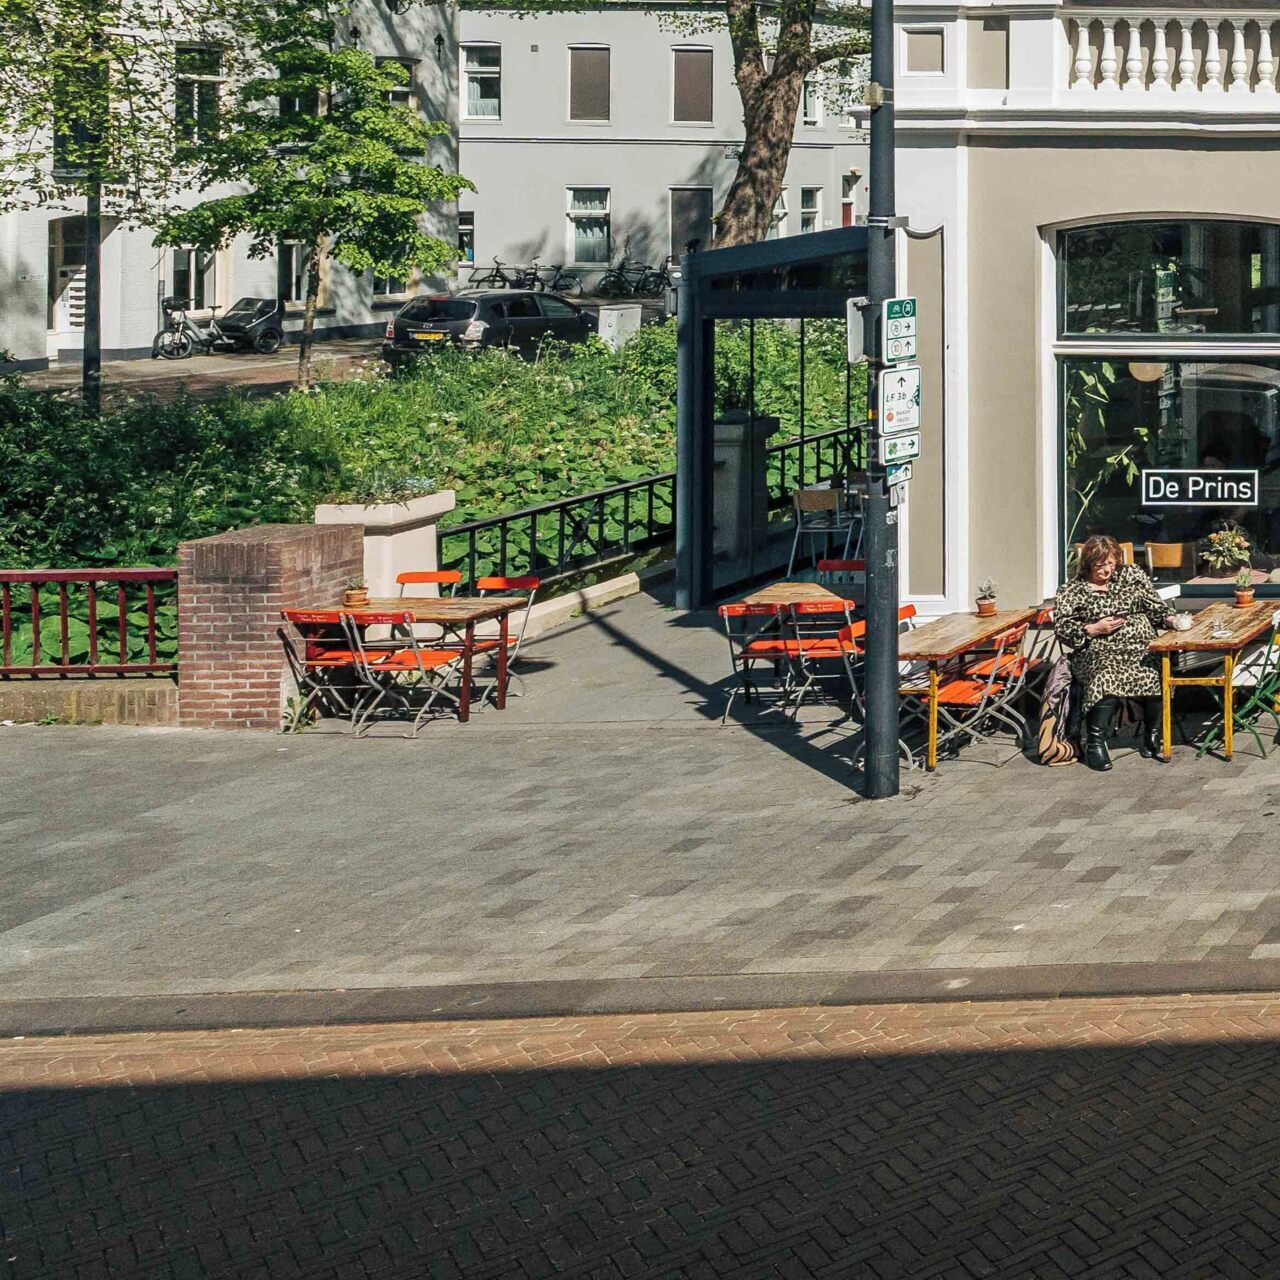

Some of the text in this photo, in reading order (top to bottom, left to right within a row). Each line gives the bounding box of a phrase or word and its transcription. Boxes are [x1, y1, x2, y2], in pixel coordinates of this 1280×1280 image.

[886, 392, 907, 403] LF 3b
[1149, 476, 1252, 499] De Prins
